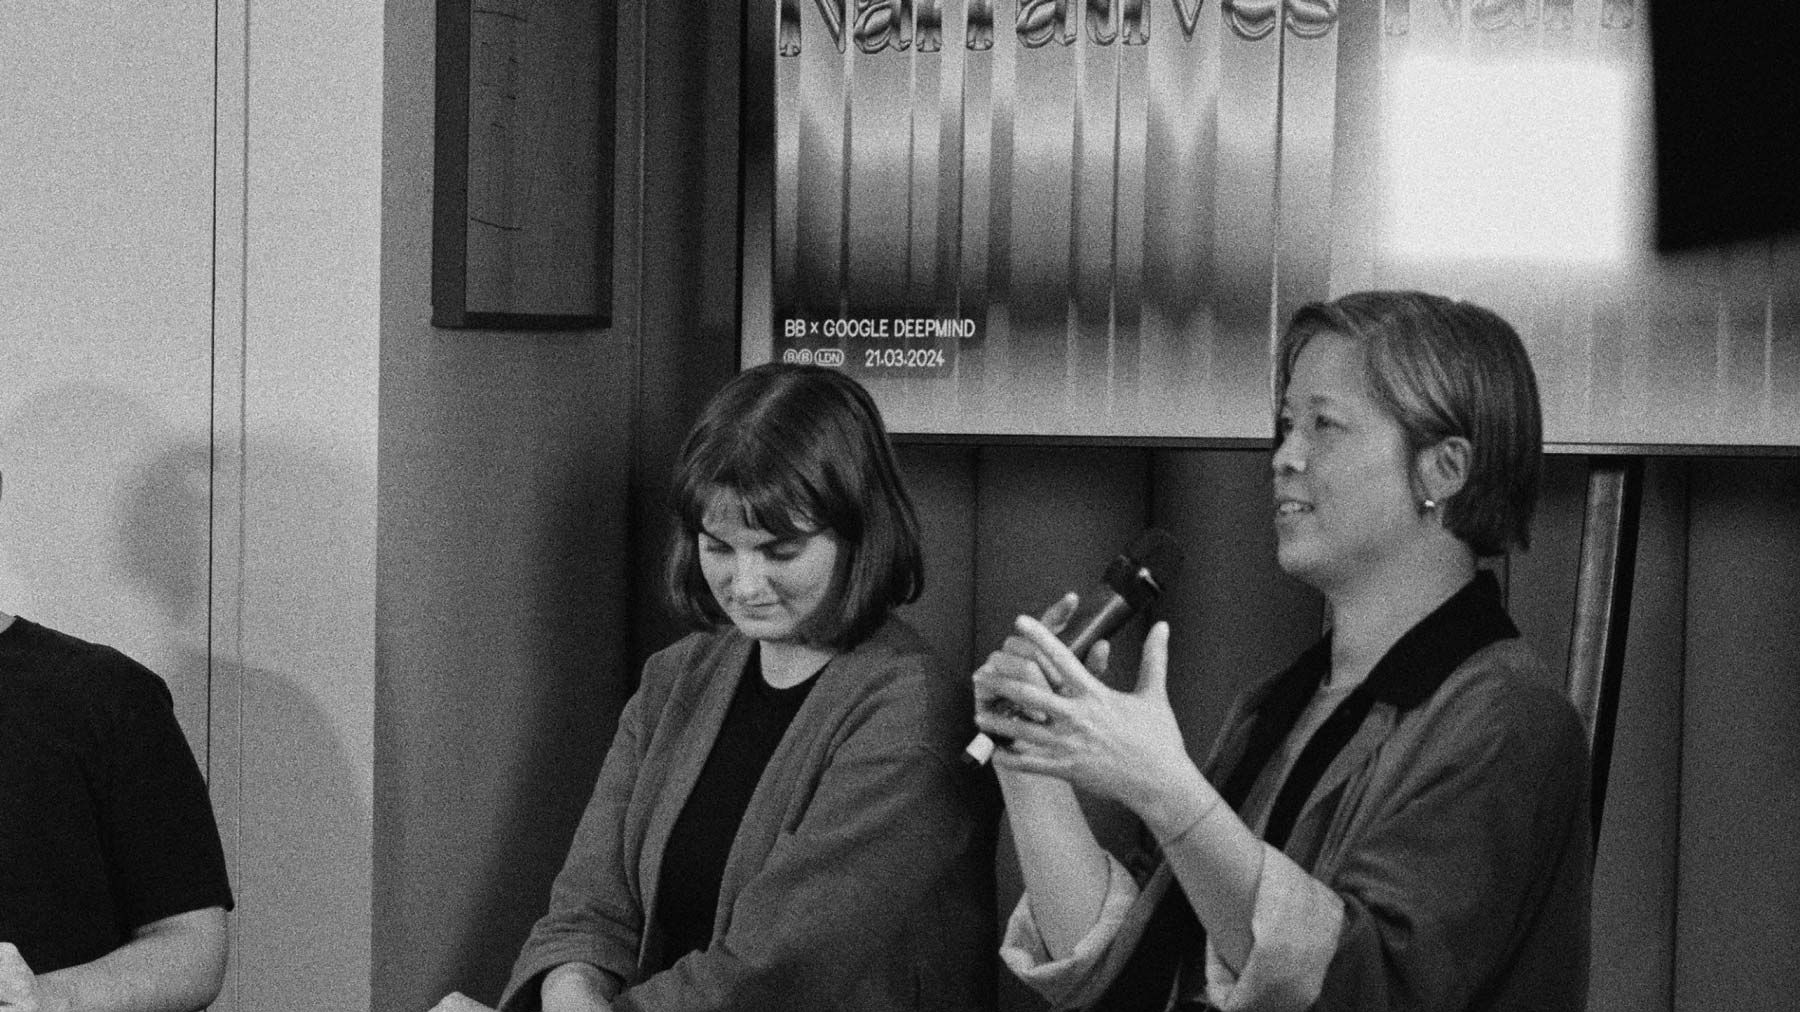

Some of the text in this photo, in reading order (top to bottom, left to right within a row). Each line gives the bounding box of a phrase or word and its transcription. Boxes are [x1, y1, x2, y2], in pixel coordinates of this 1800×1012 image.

[784, 319, 806, 337] BB
[823, 319, 889, 337] GOOGLE
[894, 319, 976, 337] DEEPMIND
[865, 349, 945, 367] 21.03.2024
